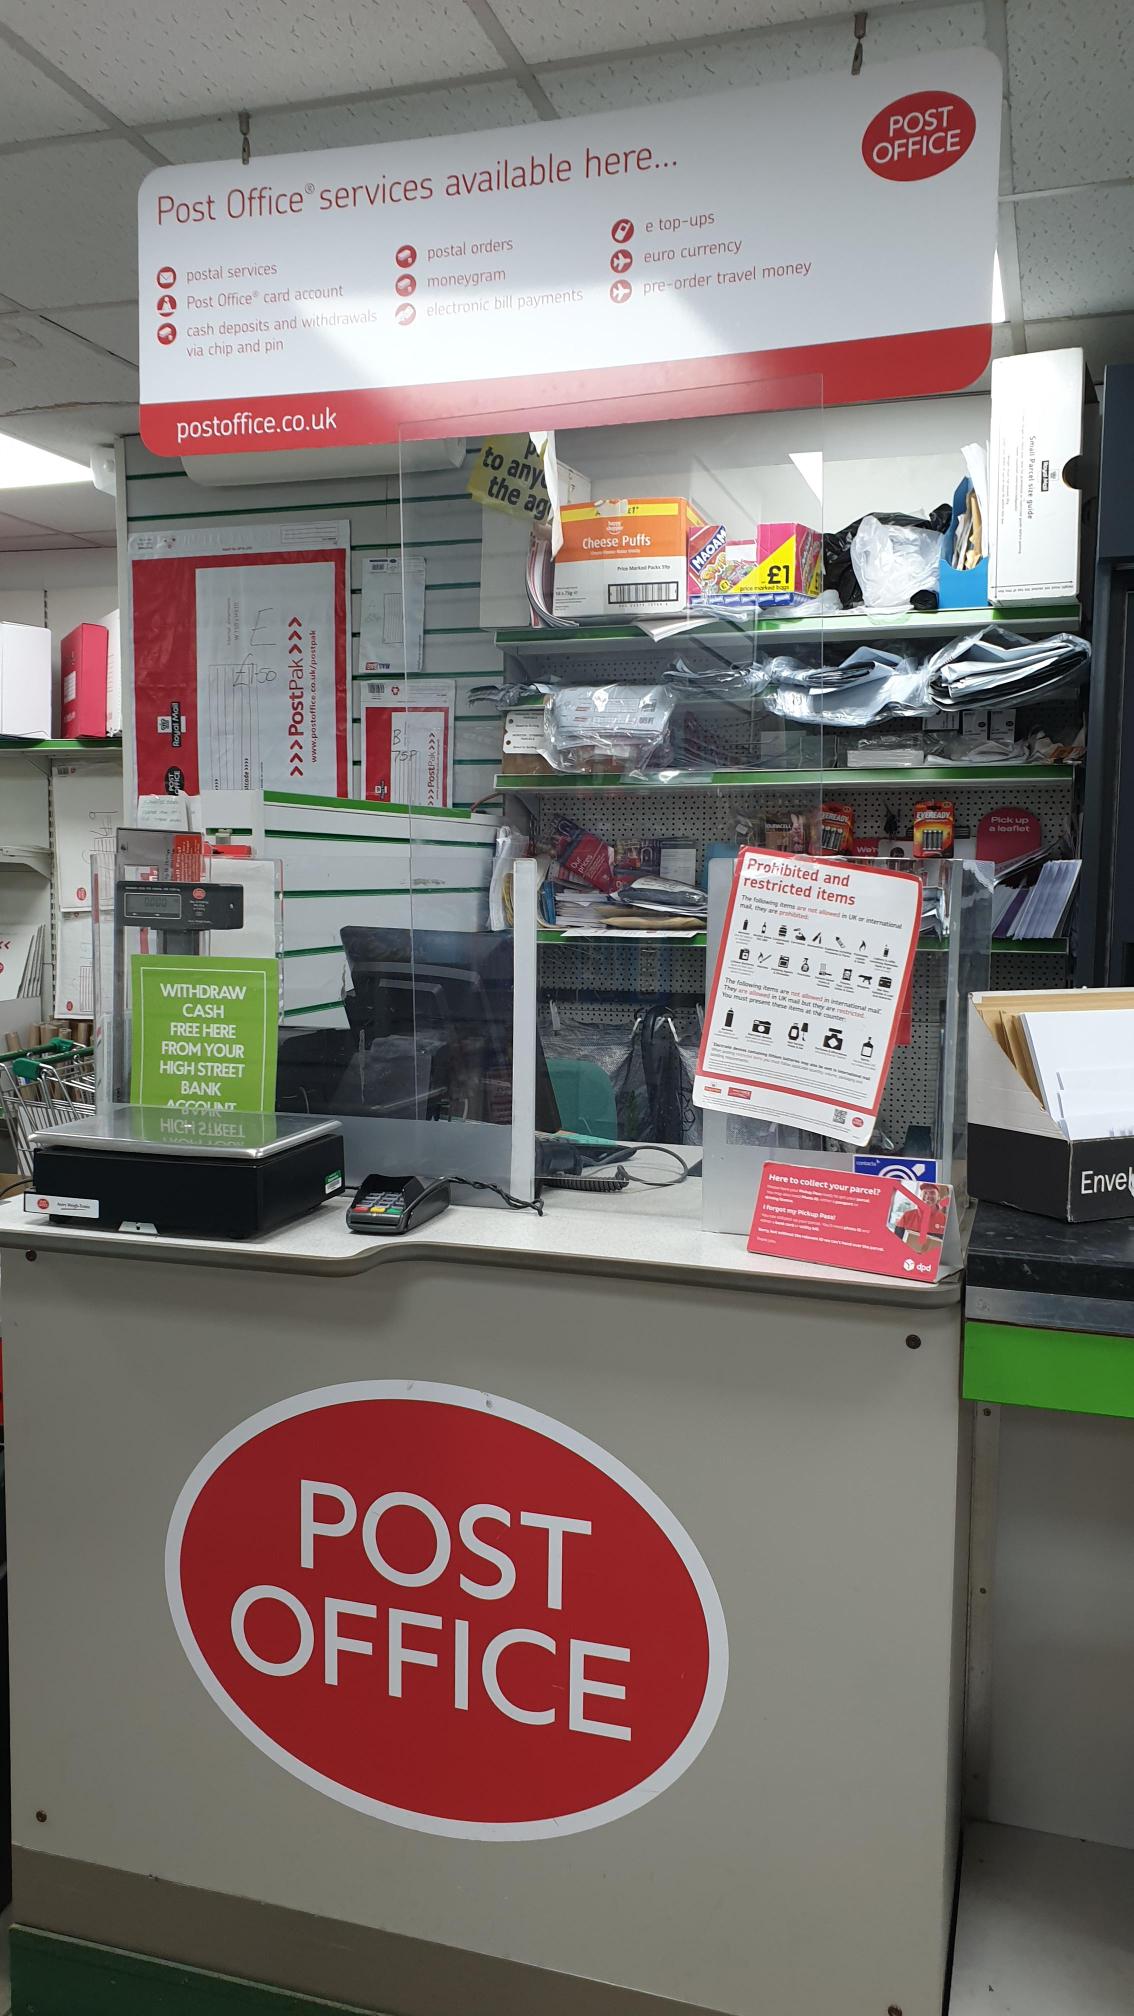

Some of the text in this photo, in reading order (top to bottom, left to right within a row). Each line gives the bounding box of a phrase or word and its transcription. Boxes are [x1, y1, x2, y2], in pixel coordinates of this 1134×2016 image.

[889, 106, 953, 137] POST
[872, 130, 962, 165] OFFICE
[157, 194, 216, 225] Post
[319, 175, 433, 211] services
[445, 153, 572, 197] available
[585, 147, 678, 178] here...
[645, 211, 715, 234] e top-ups
[427, 237, 513, 262] postal orders
[643, 239, 743, 264] euro currency
[186, 262, 278, 284] postal services
[426, 268, 506, 291] moneygram
[643, 260, 813, 296] pre-order travel money
[186, 293, 214, 310] Post
[263, 289, 291, 305] card
[294, 285, 343, 301] account
[426, 289, 584, 318] electronic bill payments
[186, 309, 377, 338] cash deposits and withdrawals
[186, 337, 284, 359] via chip and pin
[176, 407, 337, 444] postoffice.co.uk
[483, 446, 504, 471] to
[1028, 458, 1036, 481] Parcel
[488, 476, 520, 505] the
[1026, 499, 1034, 520] guide
[583, 534, 651, 549] Cheese Puffs
[691, 525, 727, 570] MAOAM
[767, 565, 789, 584] £1
[287, 658, 304, 737] PostPak
[310, 629, 318, 763] www.postoffice.co.uk/postpak
[172, 723, 181, 747] Royal
[427, 751, 436, 788] PostPak
[917, 811, 950, 819] EVEREADY
[991, 816, 1029, 825] Pick up
[747, 858, 850, 887] Prohibited and
[744, 877, 855, 906] restricted items
[753, 897, 778, 908] following
[780, 901, 795, 910] items
[866, 917, 903, 929] international
[754, 905, 767, 914] they
[160, 983, 247, 1000] WITHDRAW
[724, 977, 736, 985] The
[736, 979, 762, 990] following
[763, 984, 778, 993] items
[831, 998, 867, 1011] international
[724, 985, 737, 993] They
[787, 997, 800, 1005] mail
[812, 1002, 824, 1012] they
[183, 1004, 224, 1019] CASH
[734, 994, 748, 1002] must
[748, 997, 771, 1006] present
[772, 1001, 788, 1009] these
[788, 1005, 804, 1013] items
[823, 1013, 846, 1022] counter.
[170, 1023, 236, 1039] FREE HERE
[161, 1041, 244, 1058] FROM YOUR
[160, 1061, 245, 1078] HIGH STREET
[181, 1081, 221, 1096] BANK
[768, 1174, 788, 1184] Here
[800, 1179, 828, 1188] collect
[829, 1183, 849, 1192] your
[850, 1184, 881, 1195] parcel?
[1081, 1166, 1134, 1194] Envel
[766, 1205, 786, 1214] forgot
[787, 1208, 797, 1216] my
[798, 1209, 818, 1219] Pickup
[917, 1264, 931, 1273] dpd
[300, 1479, 592, 1610] POST
[230, 1584, 632, 1742] OFFICE
